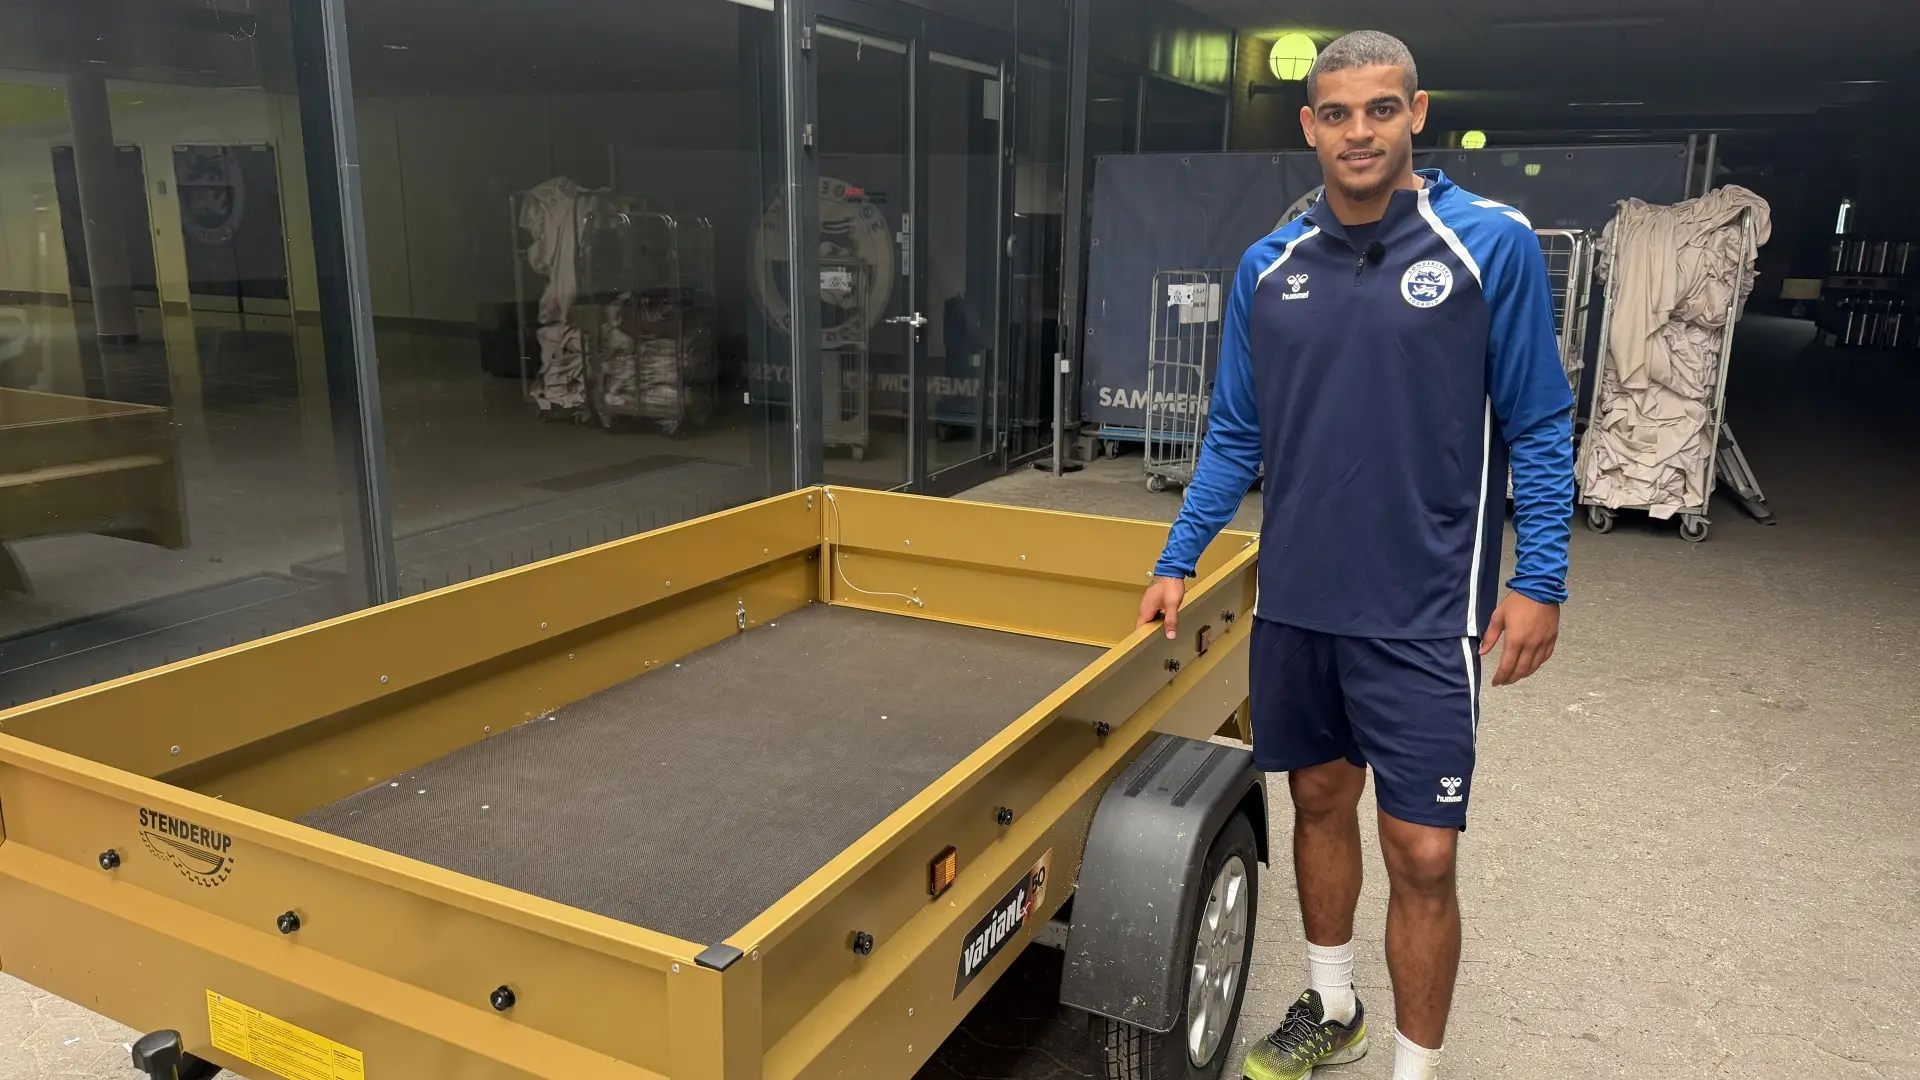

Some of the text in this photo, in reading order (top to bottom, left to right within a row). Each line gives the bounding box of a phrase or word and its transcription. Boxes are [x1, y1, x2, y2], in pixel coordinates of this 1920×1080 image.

[1282, 291, 1309, 300] hummel
[1436, 794, 1462, 802] hummel
[139, 807, 232, 853] STENDERUP
[964, 865, 1046, 977] variant 50
